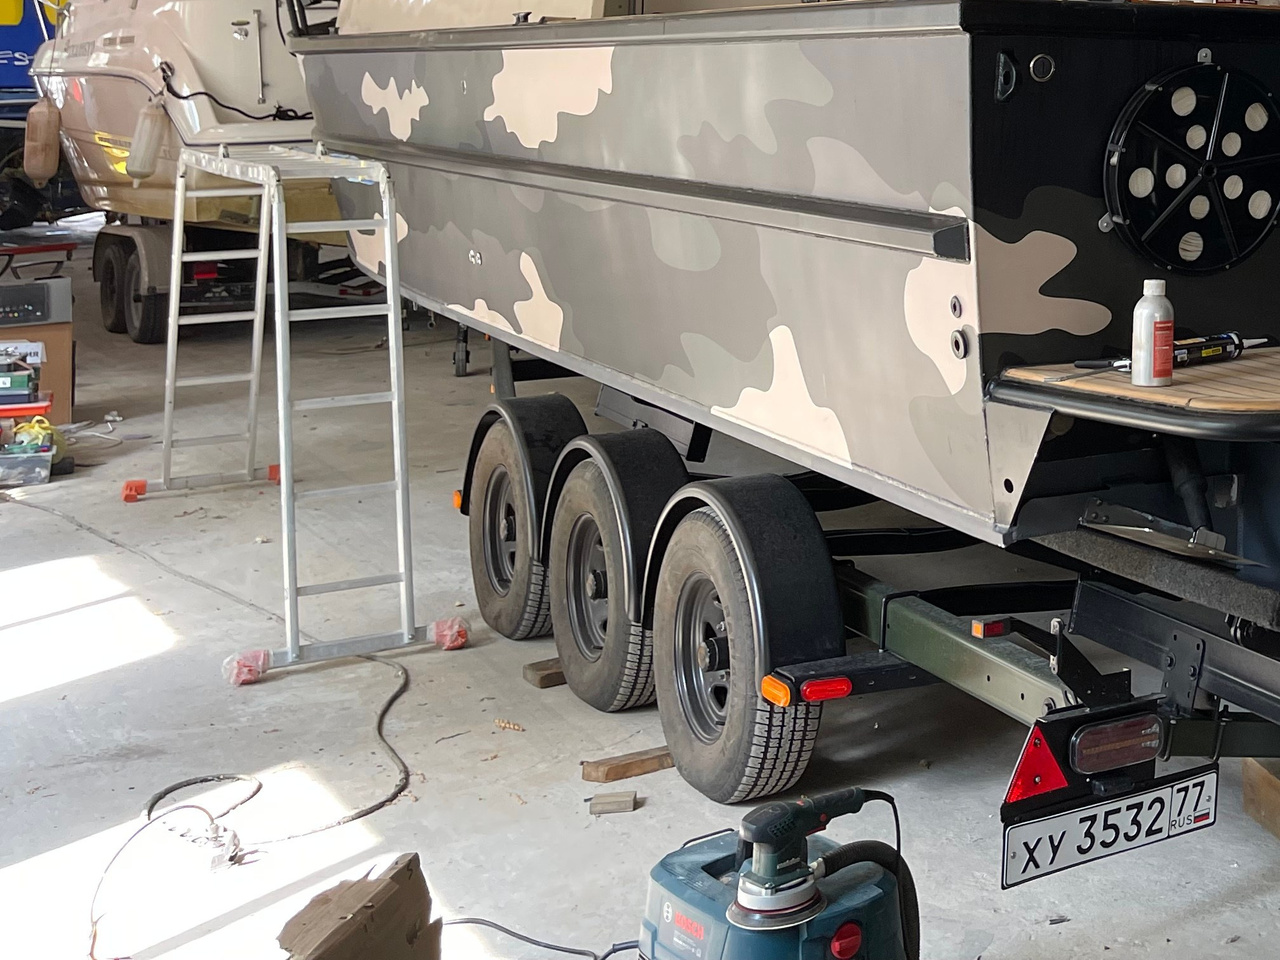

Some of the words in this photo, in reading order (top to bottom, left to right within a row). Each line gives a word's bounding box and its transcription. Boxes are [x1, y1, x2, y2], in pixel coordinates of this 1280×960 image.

[1076, 796, 1166, 855] 3532
[1176, 780, 1205, 818] 77
[1170, 814, 1193, 830] RUS
[674, 911, 704, 940] BOSCH
